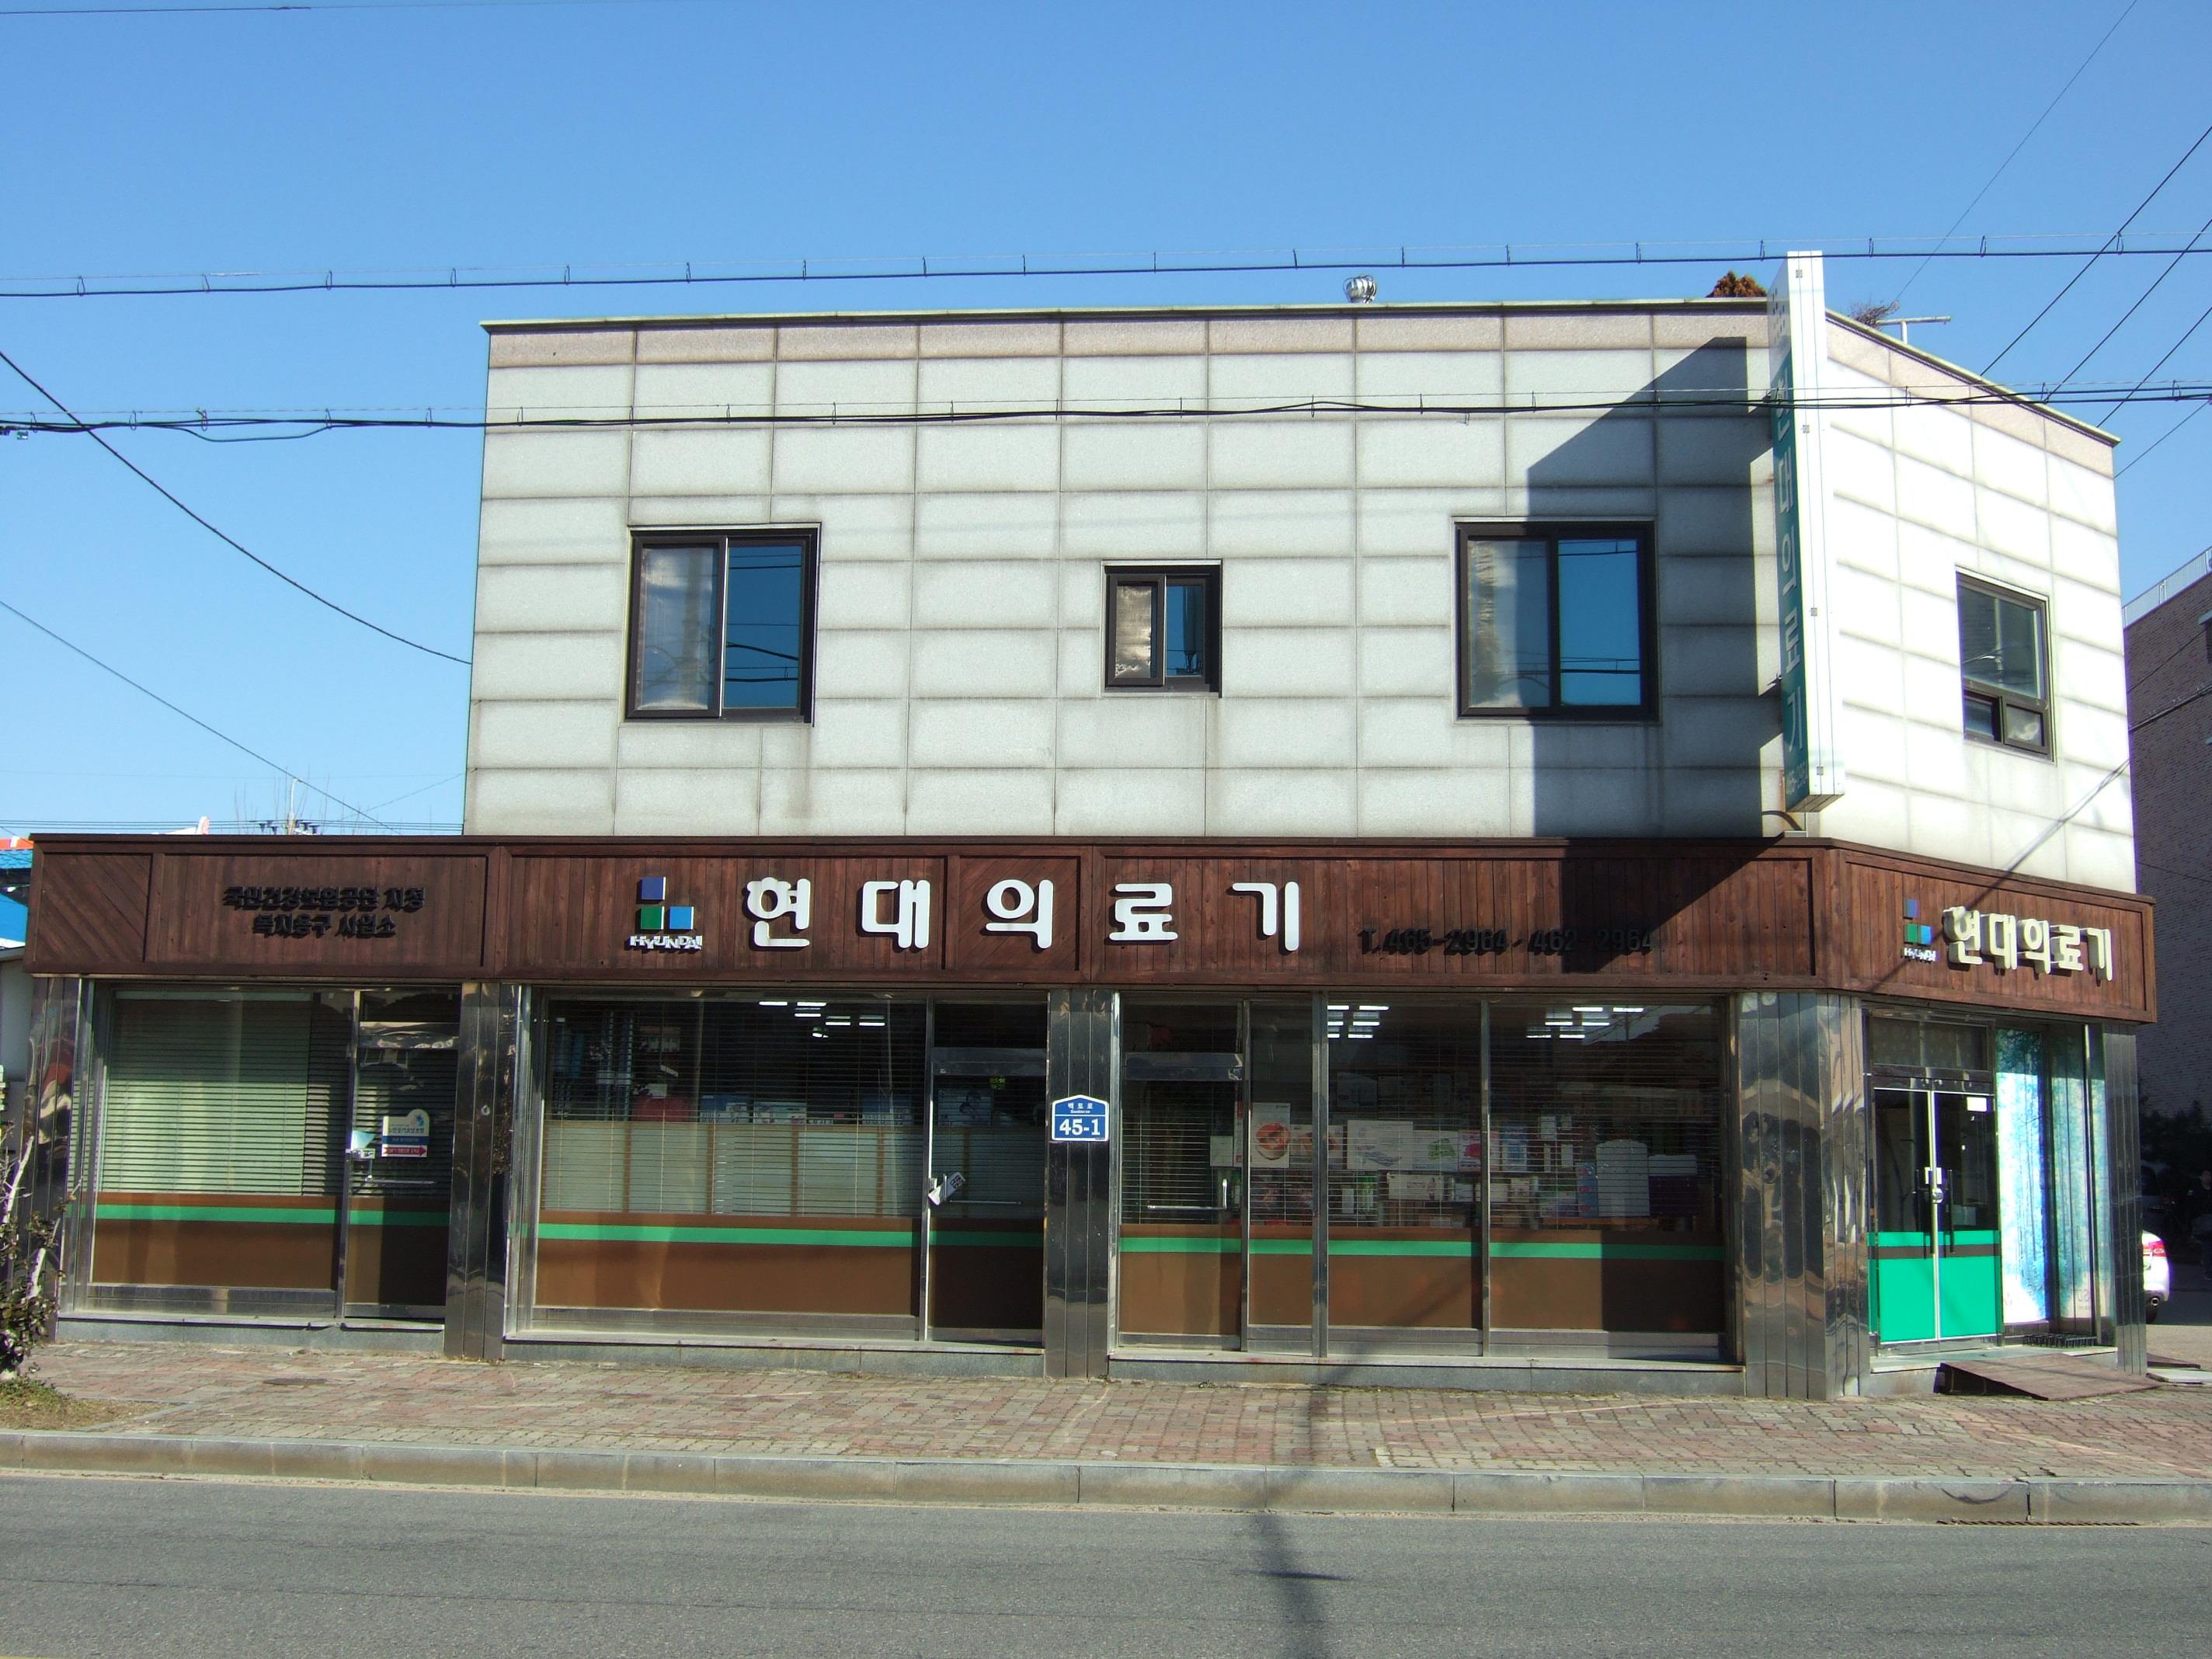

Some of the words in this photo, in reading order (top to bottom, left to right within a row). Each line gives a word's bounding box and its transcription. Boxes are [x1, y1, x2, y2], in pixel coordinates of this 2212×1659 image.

[253, 913, 332, 936] 복지용구
[337, 913, 396, 937] 사업소
[629, 934, 704, 951] HYUNDAI
[1942, 906, 2113, 982] 현대의료기
[1059, 1118, 1101, 1136] 45-1
